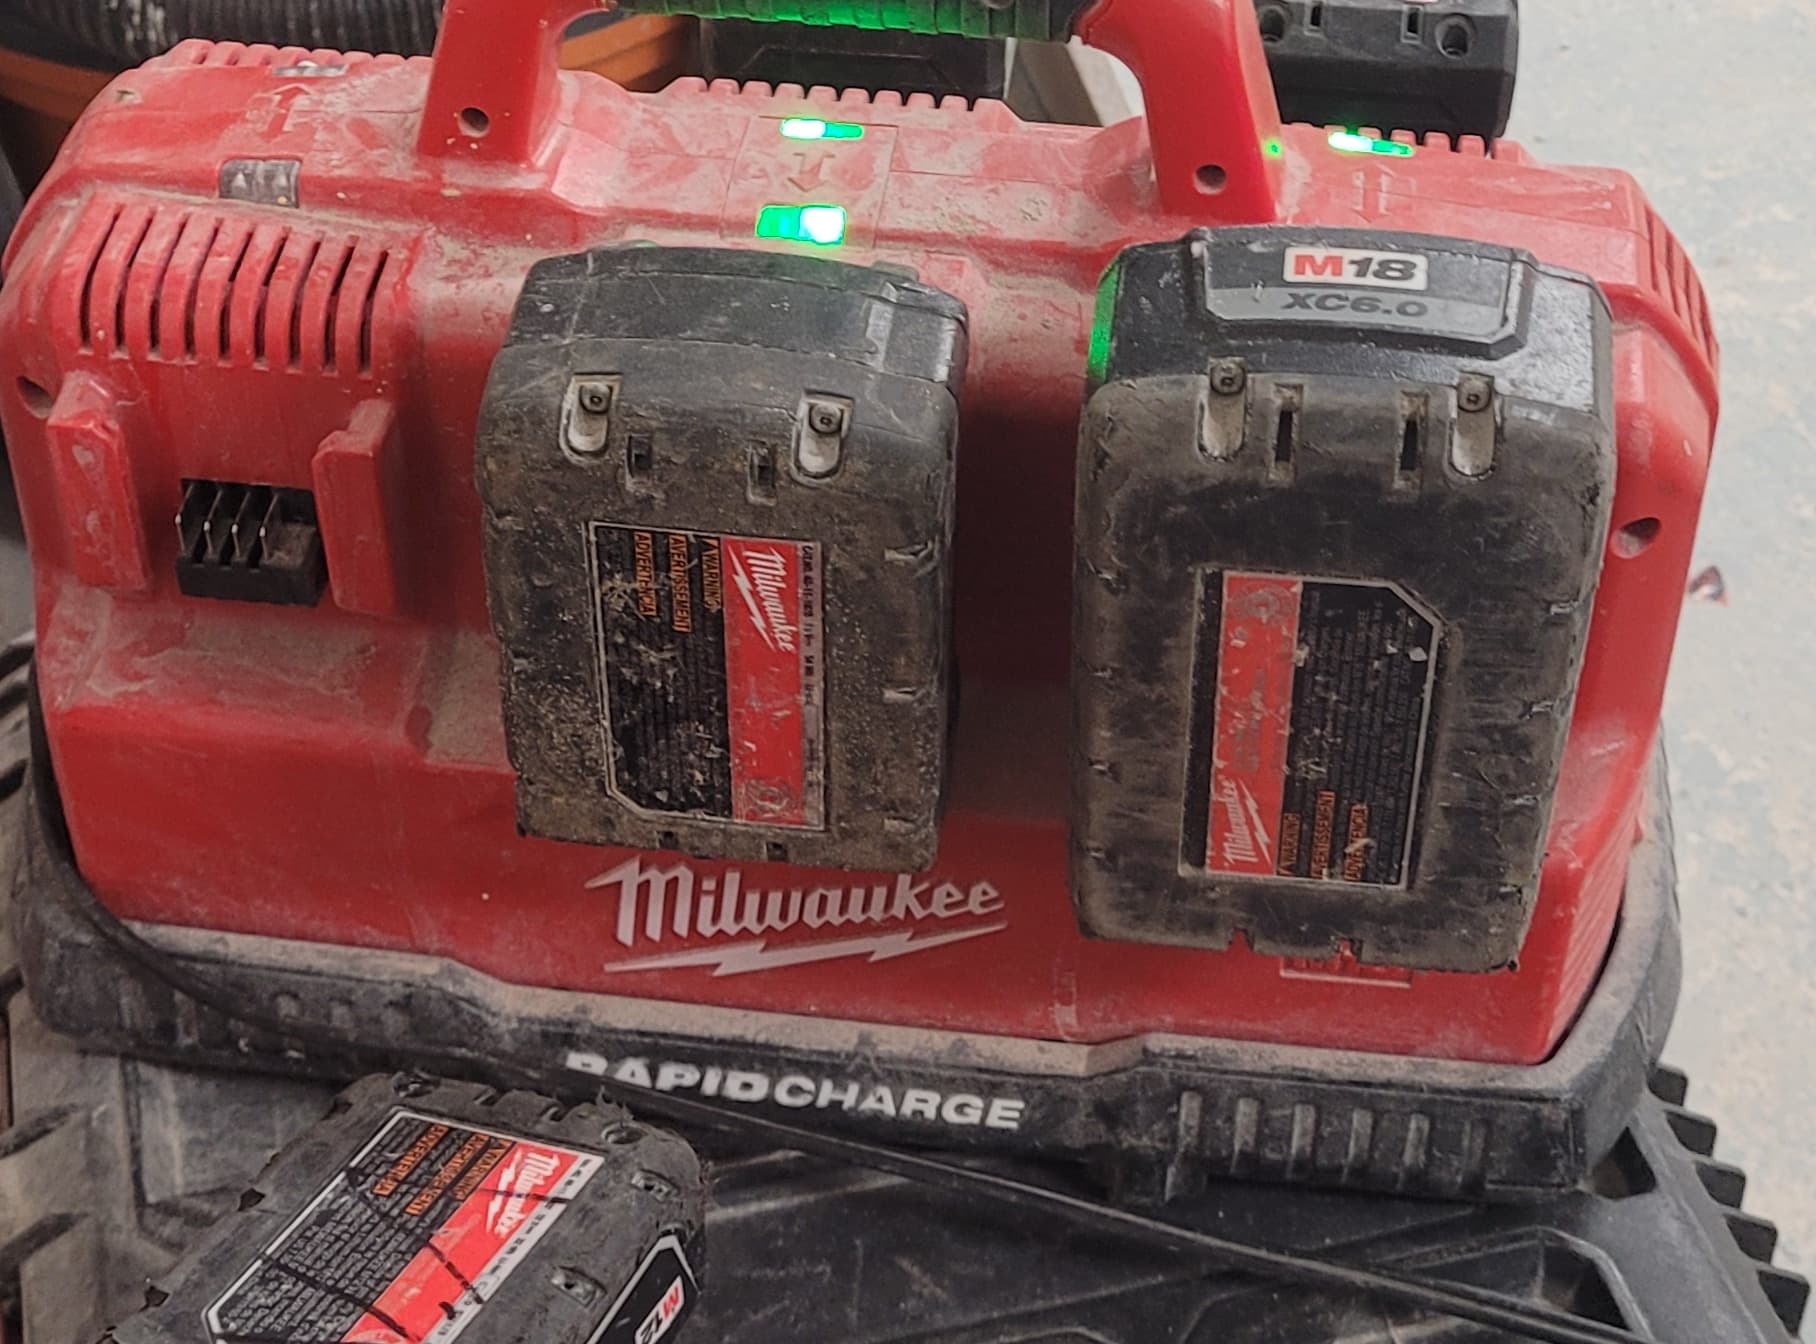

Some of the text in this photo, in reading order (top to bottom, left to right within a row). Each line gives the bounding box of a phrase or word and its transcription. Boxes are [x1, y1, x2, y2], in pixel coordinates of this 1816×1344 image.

[1281, 292, 1428, 318] XC6.0
[1293, 254, 1418, 281] M18
[743, 546, 797, 653] Milwaukee
[1223, 778, 1257, 865] Milwaukee
[584, 856, 1004, 947] Milwaukee
